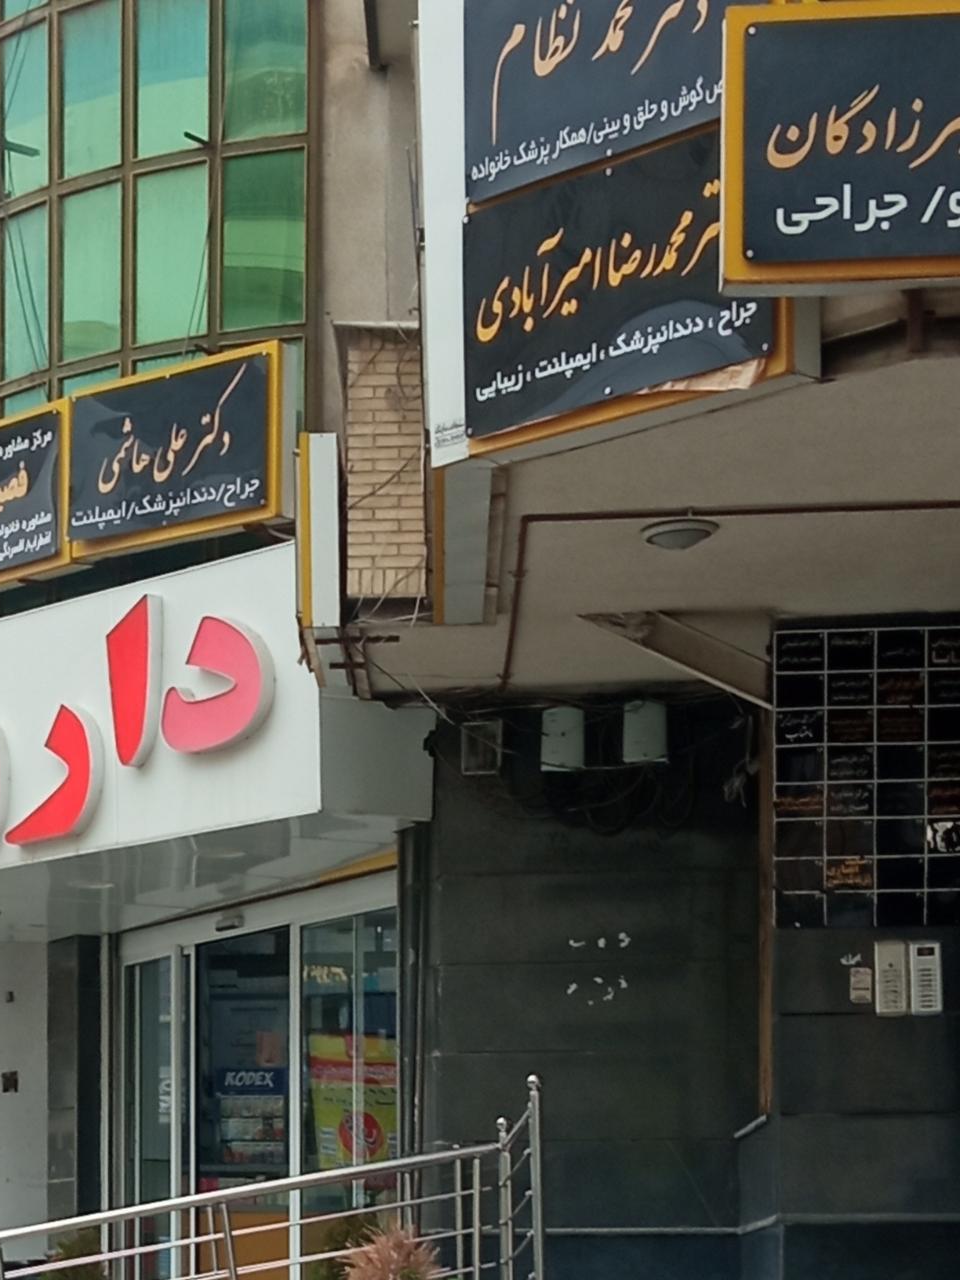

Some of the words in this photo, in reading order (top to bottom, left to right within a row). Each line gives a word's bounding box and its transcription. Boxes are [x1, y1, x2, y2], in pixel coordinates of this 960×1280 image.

[634, 99, 658, 130] حلق
[660, 99, 670, 121] و
[671, 76, 704, 117] گوش
[622, 112, 632, 134] و
[470, 148, 512, 182] خانواده
[512, 137, 551, 166] پزشک
[775, 183, 908, 235] جراحی
[608, 313, 704, 358] دندانپزشک
[717, 301, 758, 336] جراح
[534, 343, 597, 380] ایمپلنت
[475, 364, 525, 402] زیبایی
[181, 362, 247, 477] دکتر
[152, 422, 188, 483] علی
[224, 1071, 275, 1088] KODEX
